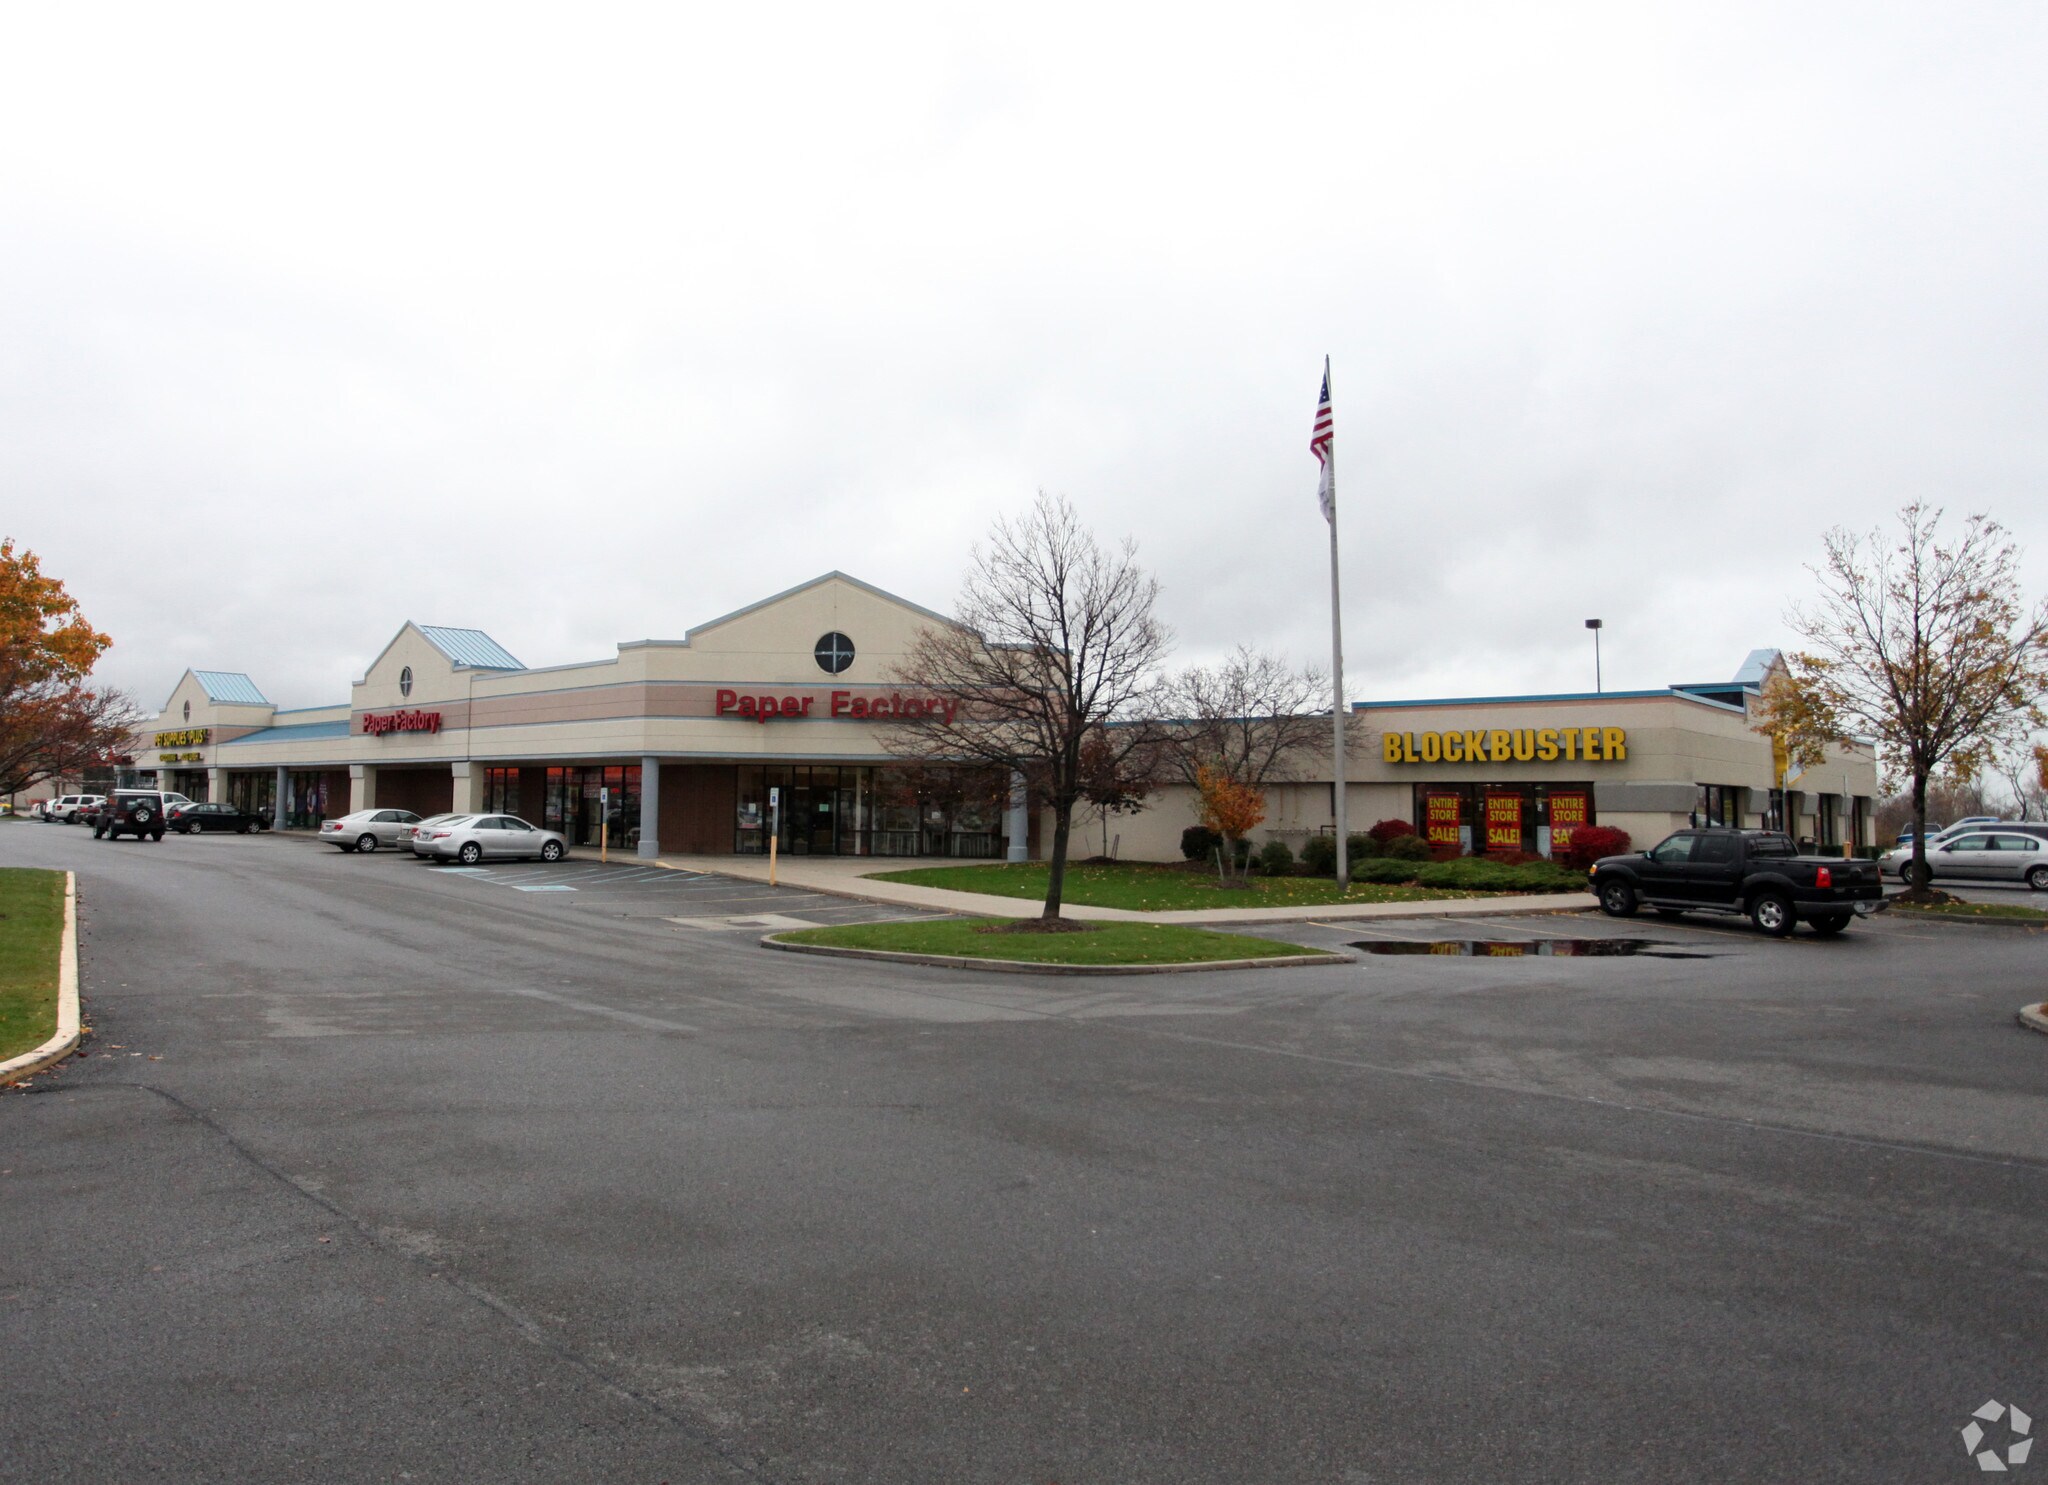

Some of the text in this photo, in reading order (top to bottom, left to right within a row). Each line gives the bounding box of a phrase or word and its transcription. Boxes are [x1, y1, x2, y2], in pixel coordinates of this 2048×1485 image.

[716, 689, 959, 726] Paper Factory
[363, 710, 440, 737] Paper Factory
[1383, 727, 1627, 763] BLOCKBUSTER
[1429, 797, 1458, 809] ENTIRE
[1488, 799, 1519, 810] ENTIRE
[1552, 798, 1584, 809] ENTIRE
[1430, 810, 1457, 820] STORE
[1489, 811, 1518, 821] STORE
[1553, 811, 1584, 821] STORE
[1428, 827, 1458, 842] SALE!
[1488, 828, 1520, 844] SALE!
